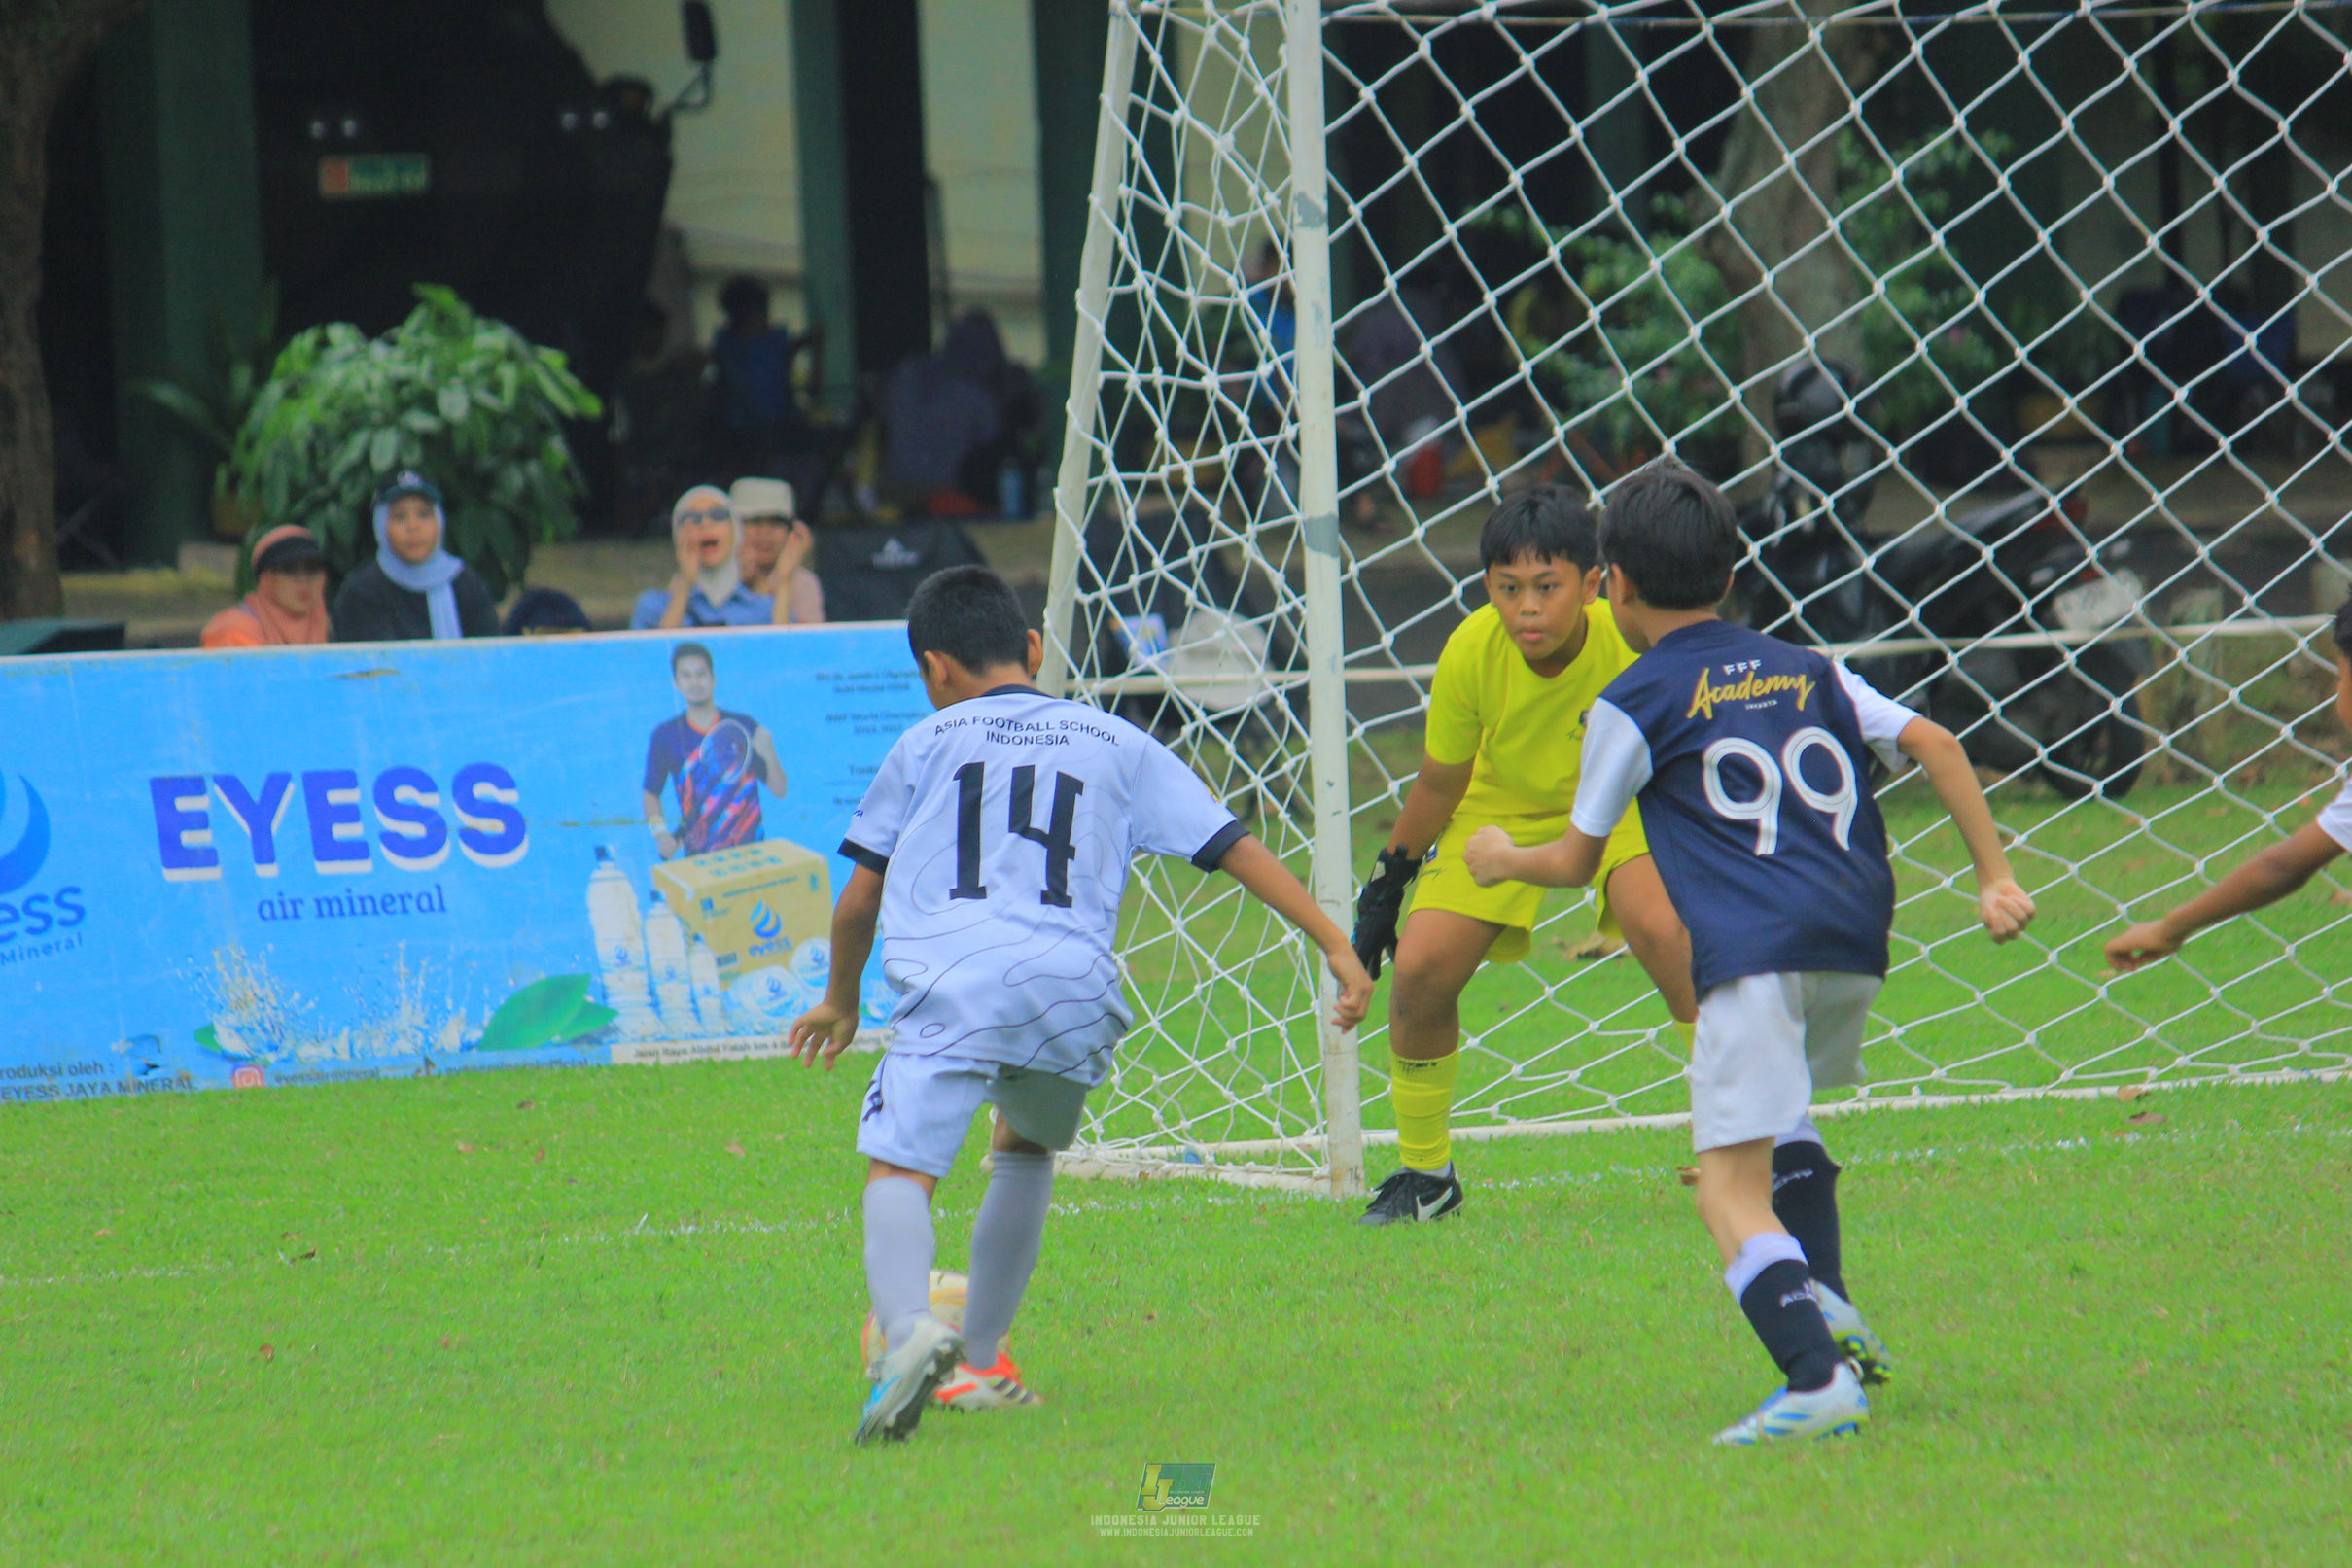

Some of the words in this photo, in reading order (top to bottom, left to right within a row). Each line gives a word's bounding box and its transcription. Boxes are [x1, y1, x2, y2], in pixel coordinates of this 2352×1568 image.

[1723, 659, 1762, 676] FFF
[1686, 667, 1816, 720] Academy
[934, 717, 968, 737] ASIA
[972, 715, 1054, 732] FOOTBALL
[1060, 719, 1120, 747] SCHOOL
[986, 730, 1071, 746] INDONESIA
[1703, 726, 1858, 856] 99
[150, 762, 529, 881] EYESS
[949, 761, 1084, 908] 14
[258, 890, 304, 922] air
[314, 883, 447, 918] mineral
